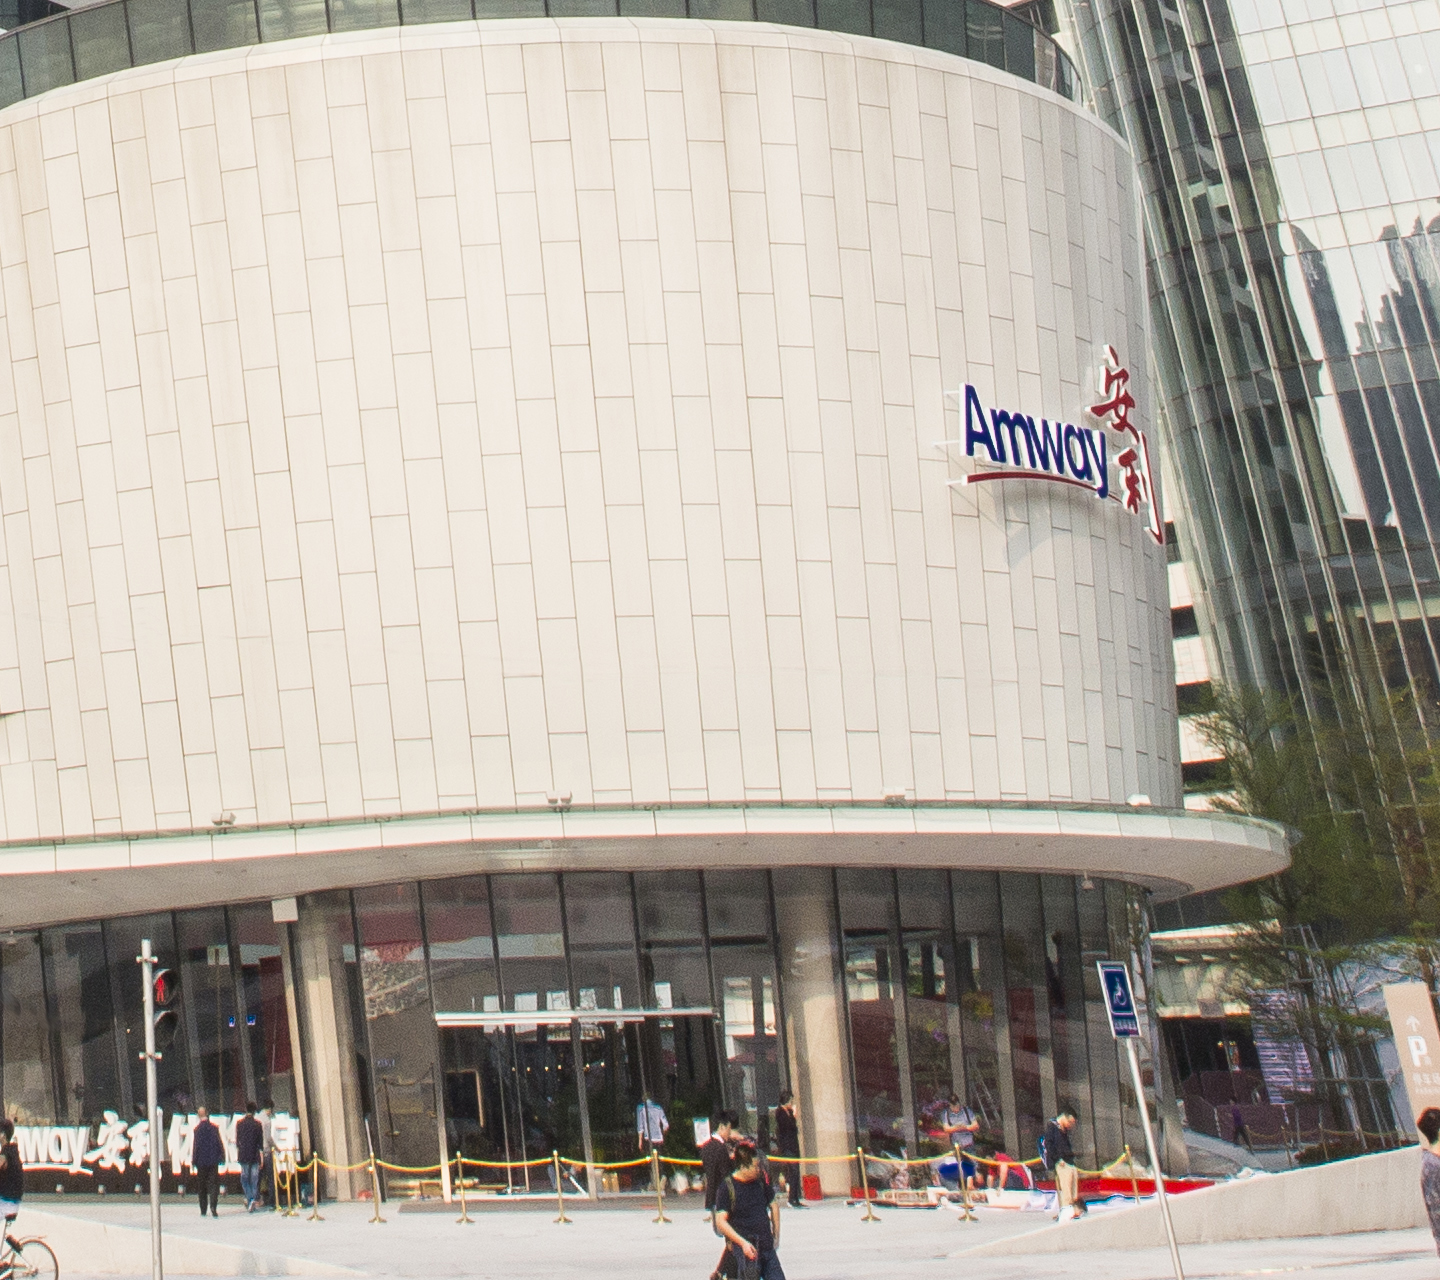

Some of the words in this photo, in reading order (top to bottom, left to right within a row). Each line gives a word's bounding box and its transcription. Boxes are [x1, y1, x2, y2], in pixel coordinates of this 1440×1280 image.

[958, 382, 1109, 500] Amway
[1085, 343, 1164, 545] 安利
[1407, 1035, 1428, 1068] P
